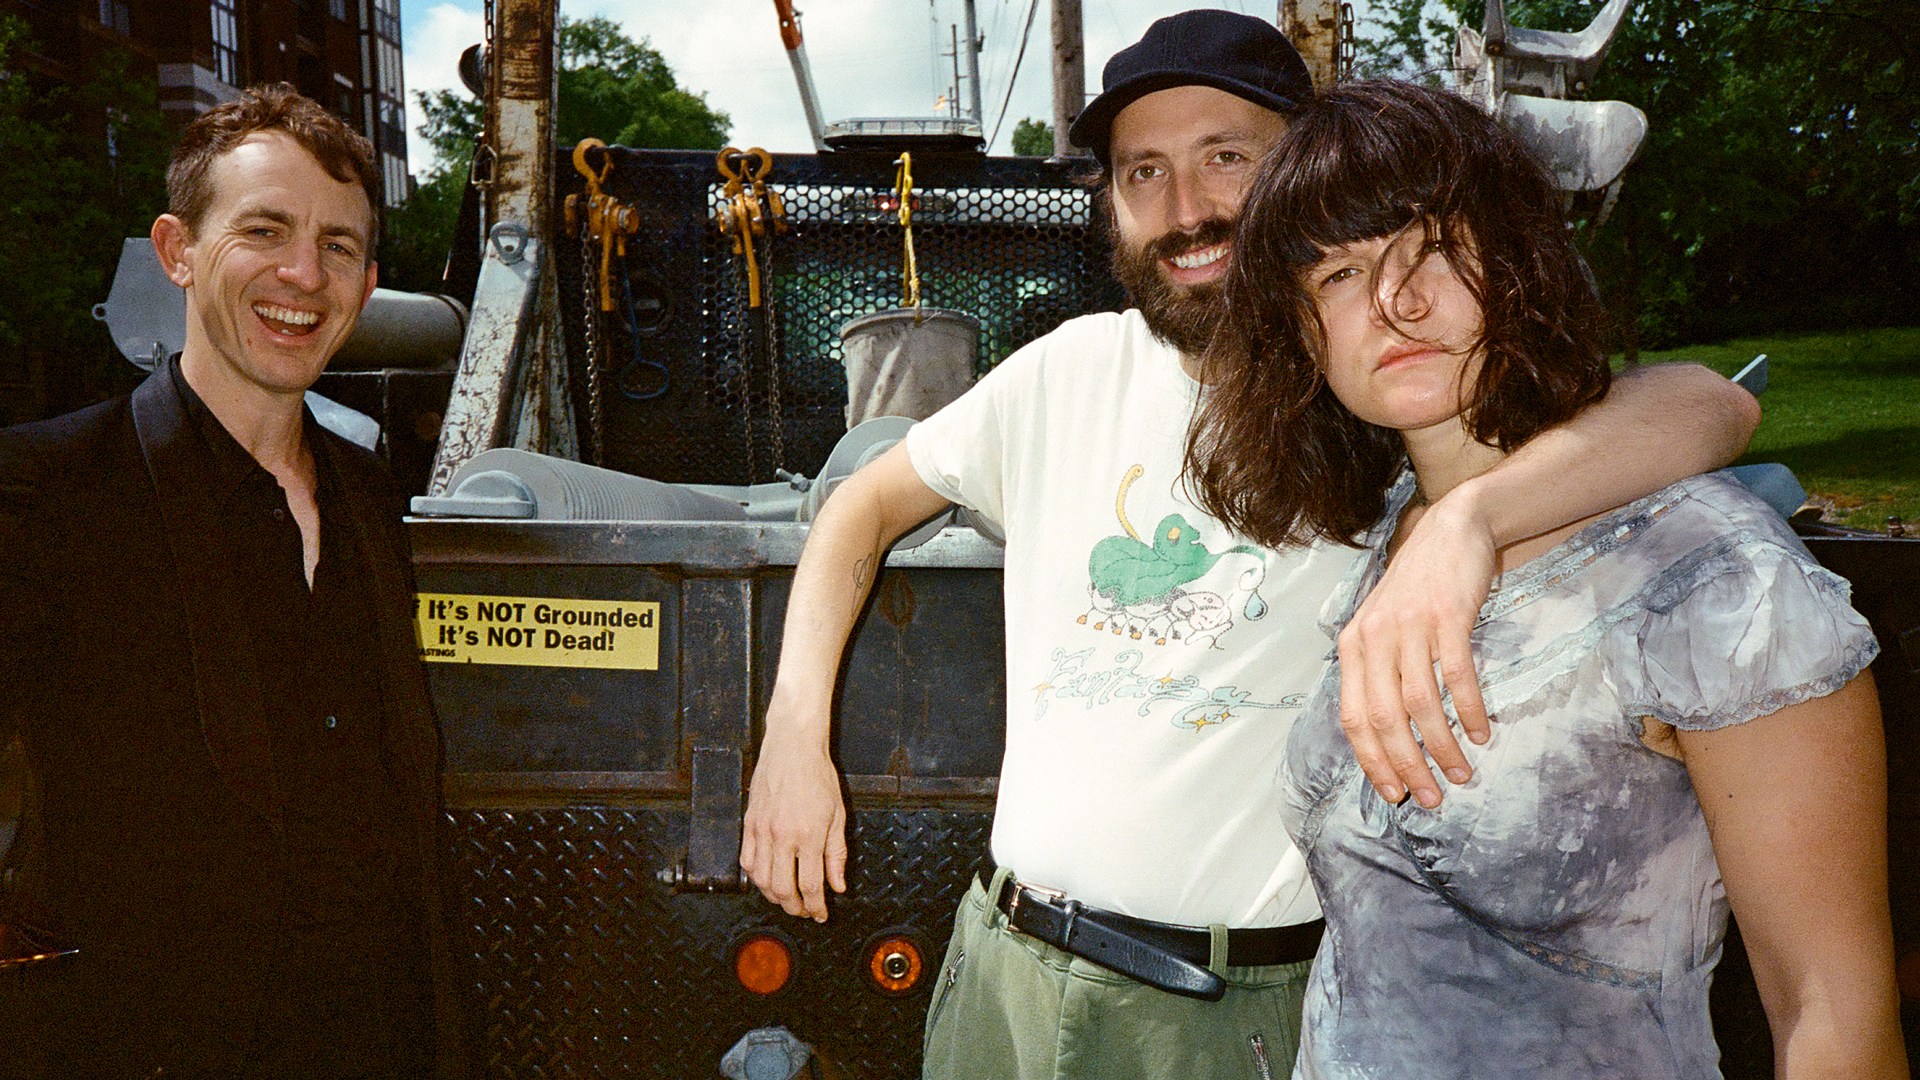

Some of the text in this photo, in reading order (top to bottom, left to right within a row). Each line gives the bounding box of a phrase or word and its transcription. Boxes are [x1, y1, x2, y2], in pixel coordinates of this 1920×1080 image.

[429, 600, 469, 620] It's
[477, 602, 526, 622] NOT
[534, 604, 654, 628] Grounded
[439, 625, 615, 651] It's NOT Dead!
[419, 647, 456, 657] ASTINGS
